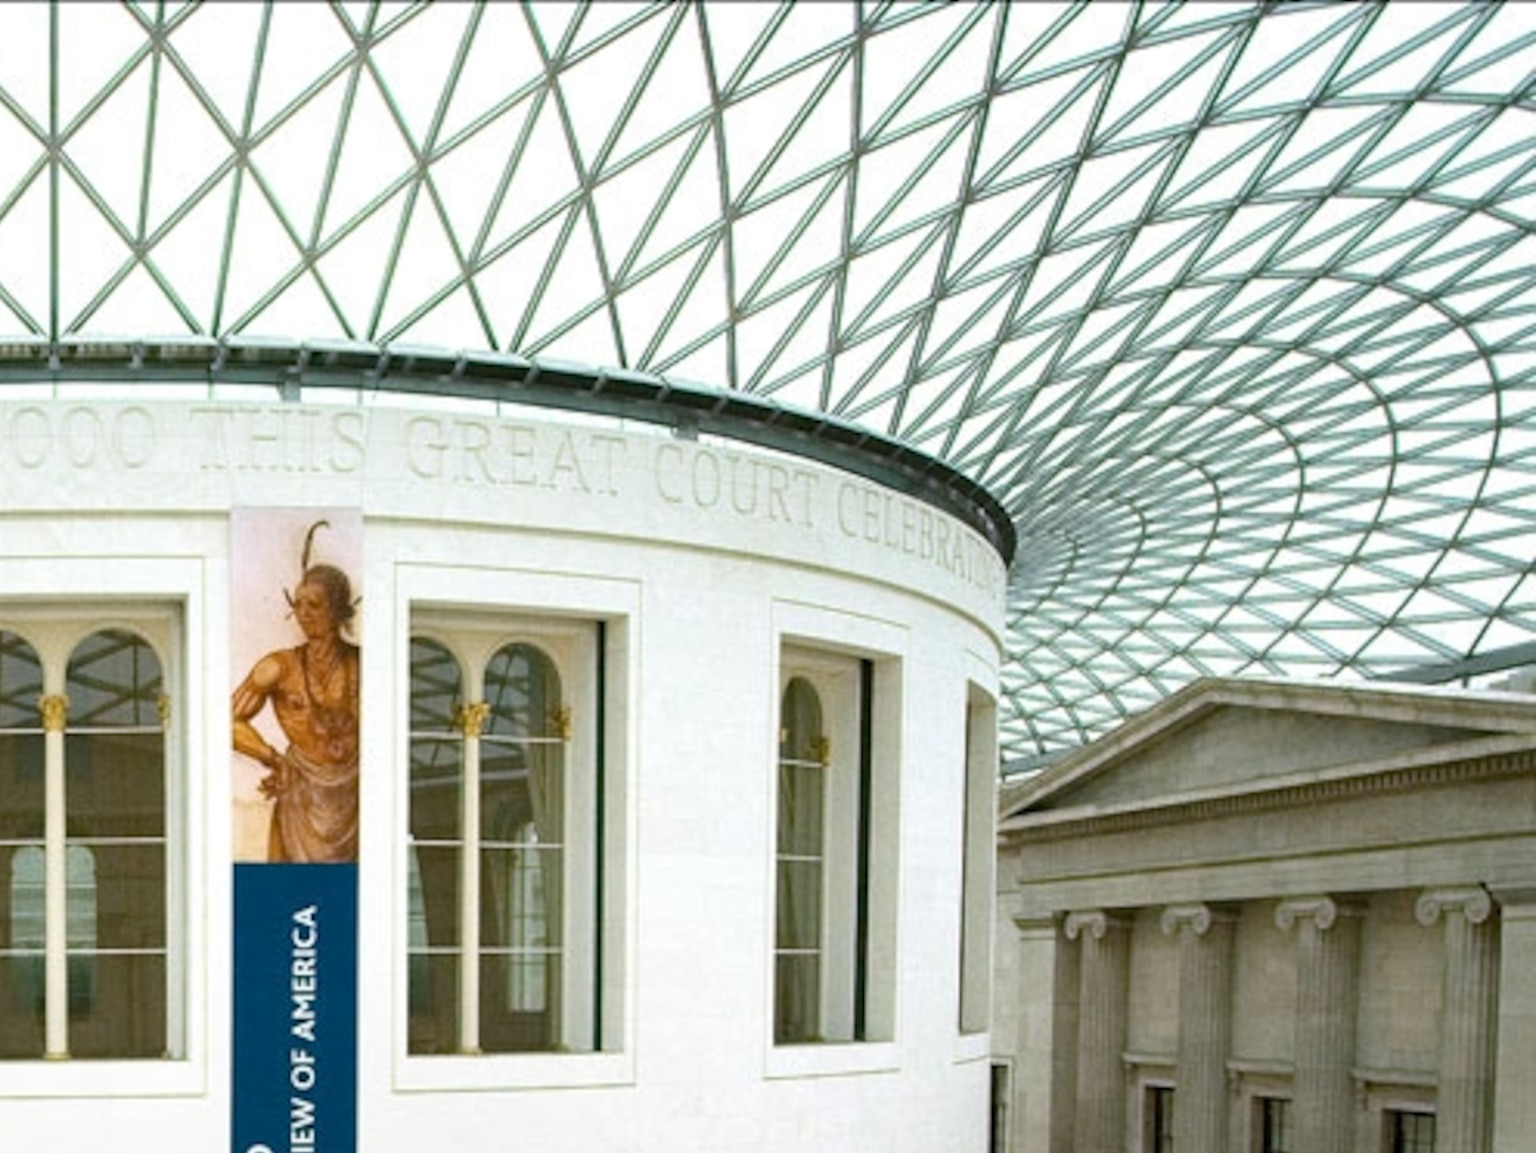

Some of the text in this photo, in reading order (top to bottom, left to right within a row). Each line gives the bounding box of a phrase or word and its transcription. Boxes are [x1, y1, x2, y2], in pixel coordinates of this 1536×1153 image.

[190, 408, 366, 473] THIS
[404, 416, 627, 496] GREAT
[655, 444, 819, 528] COURT
[291, 905, 318, 1042] AMERICA
[290, 1049, 315, 1089] OF
